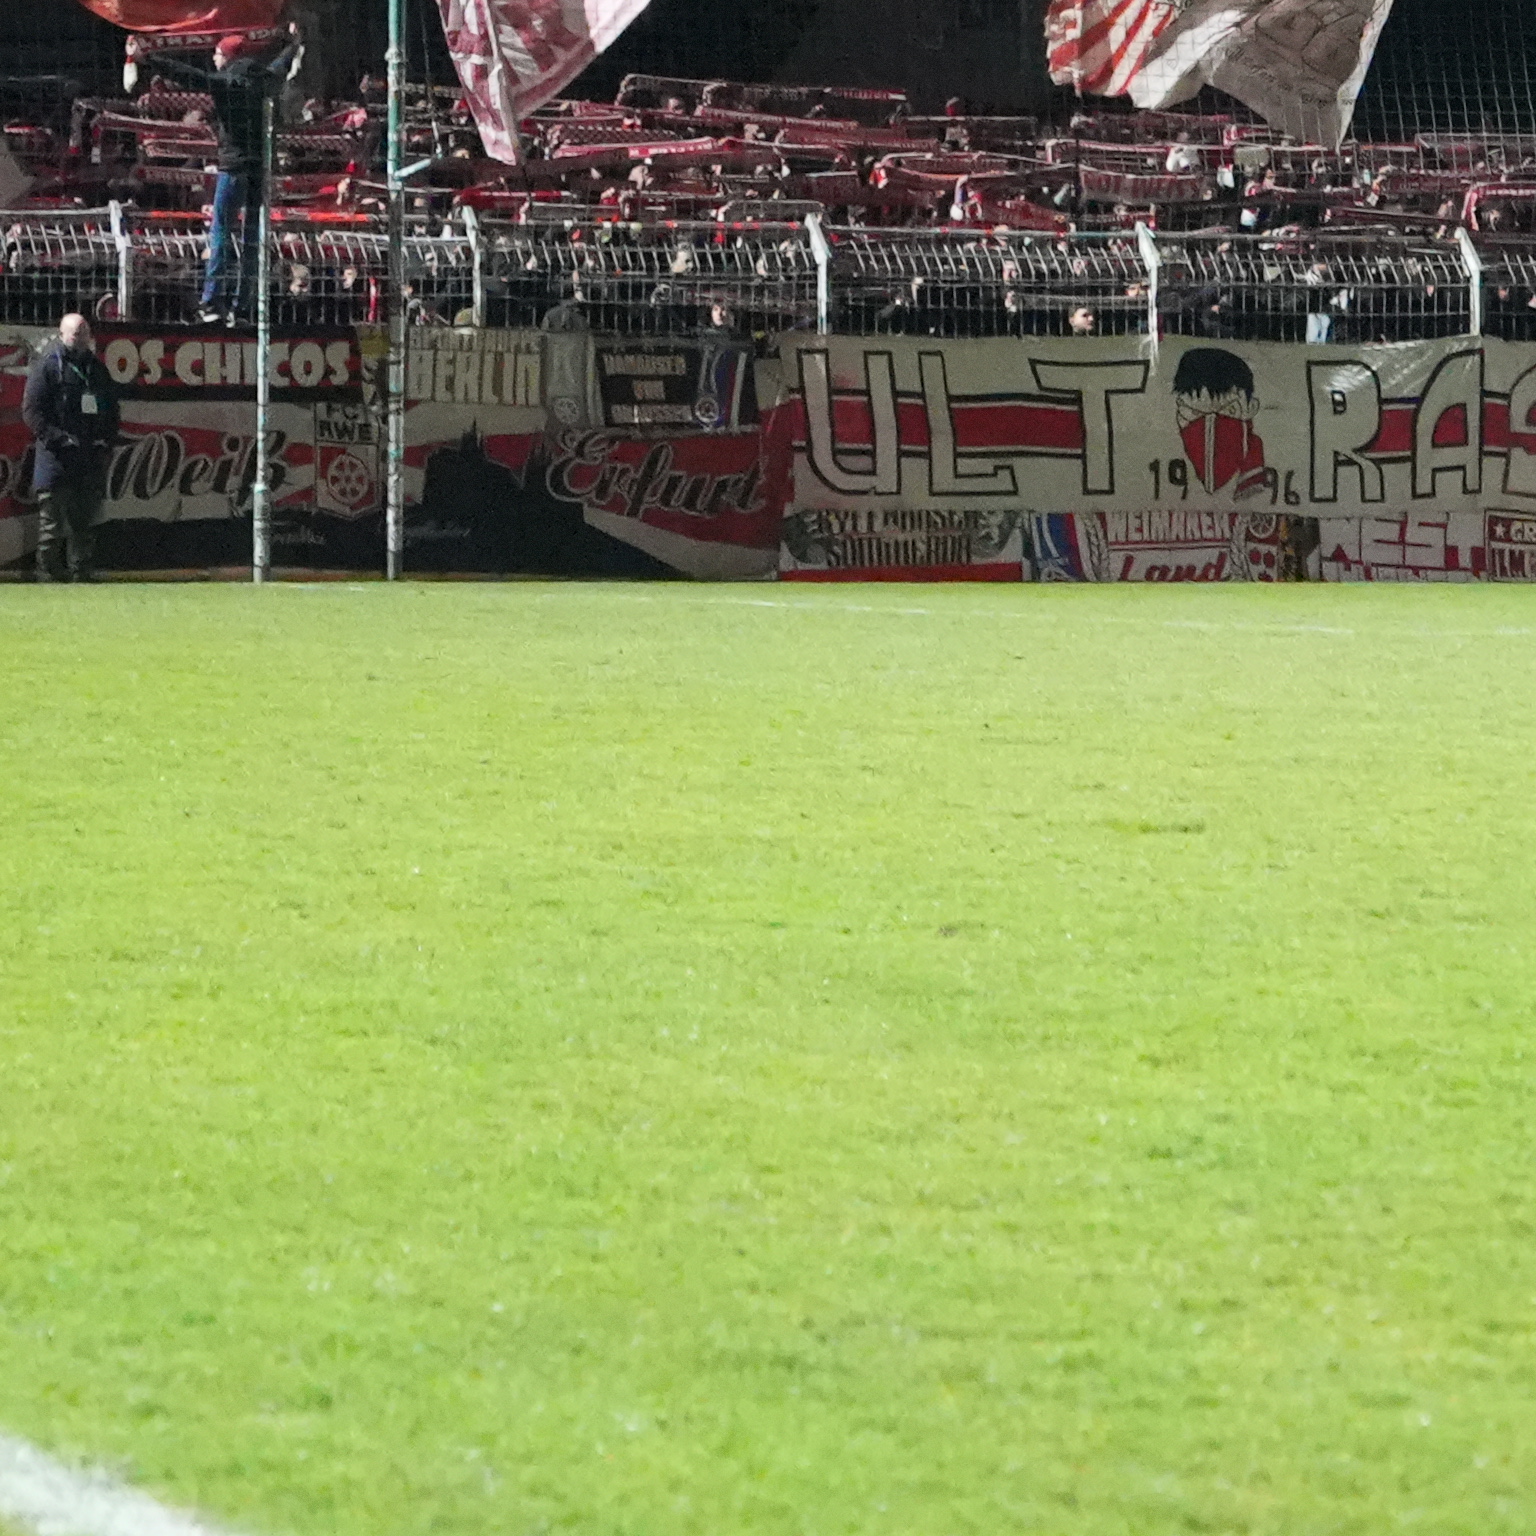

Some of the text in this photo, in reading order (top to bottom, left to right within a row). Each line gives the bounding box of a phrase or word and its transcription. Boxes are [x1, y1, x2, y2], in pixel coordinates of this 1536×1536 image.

[174, 340, 351, 387] CHICOS
[319, 422, 375, 443] RWE
[547, 428, 768, 518] Erfurt
[1148, 458, 1189, 500] 19
[1119, 551, 1232, 582] Land
